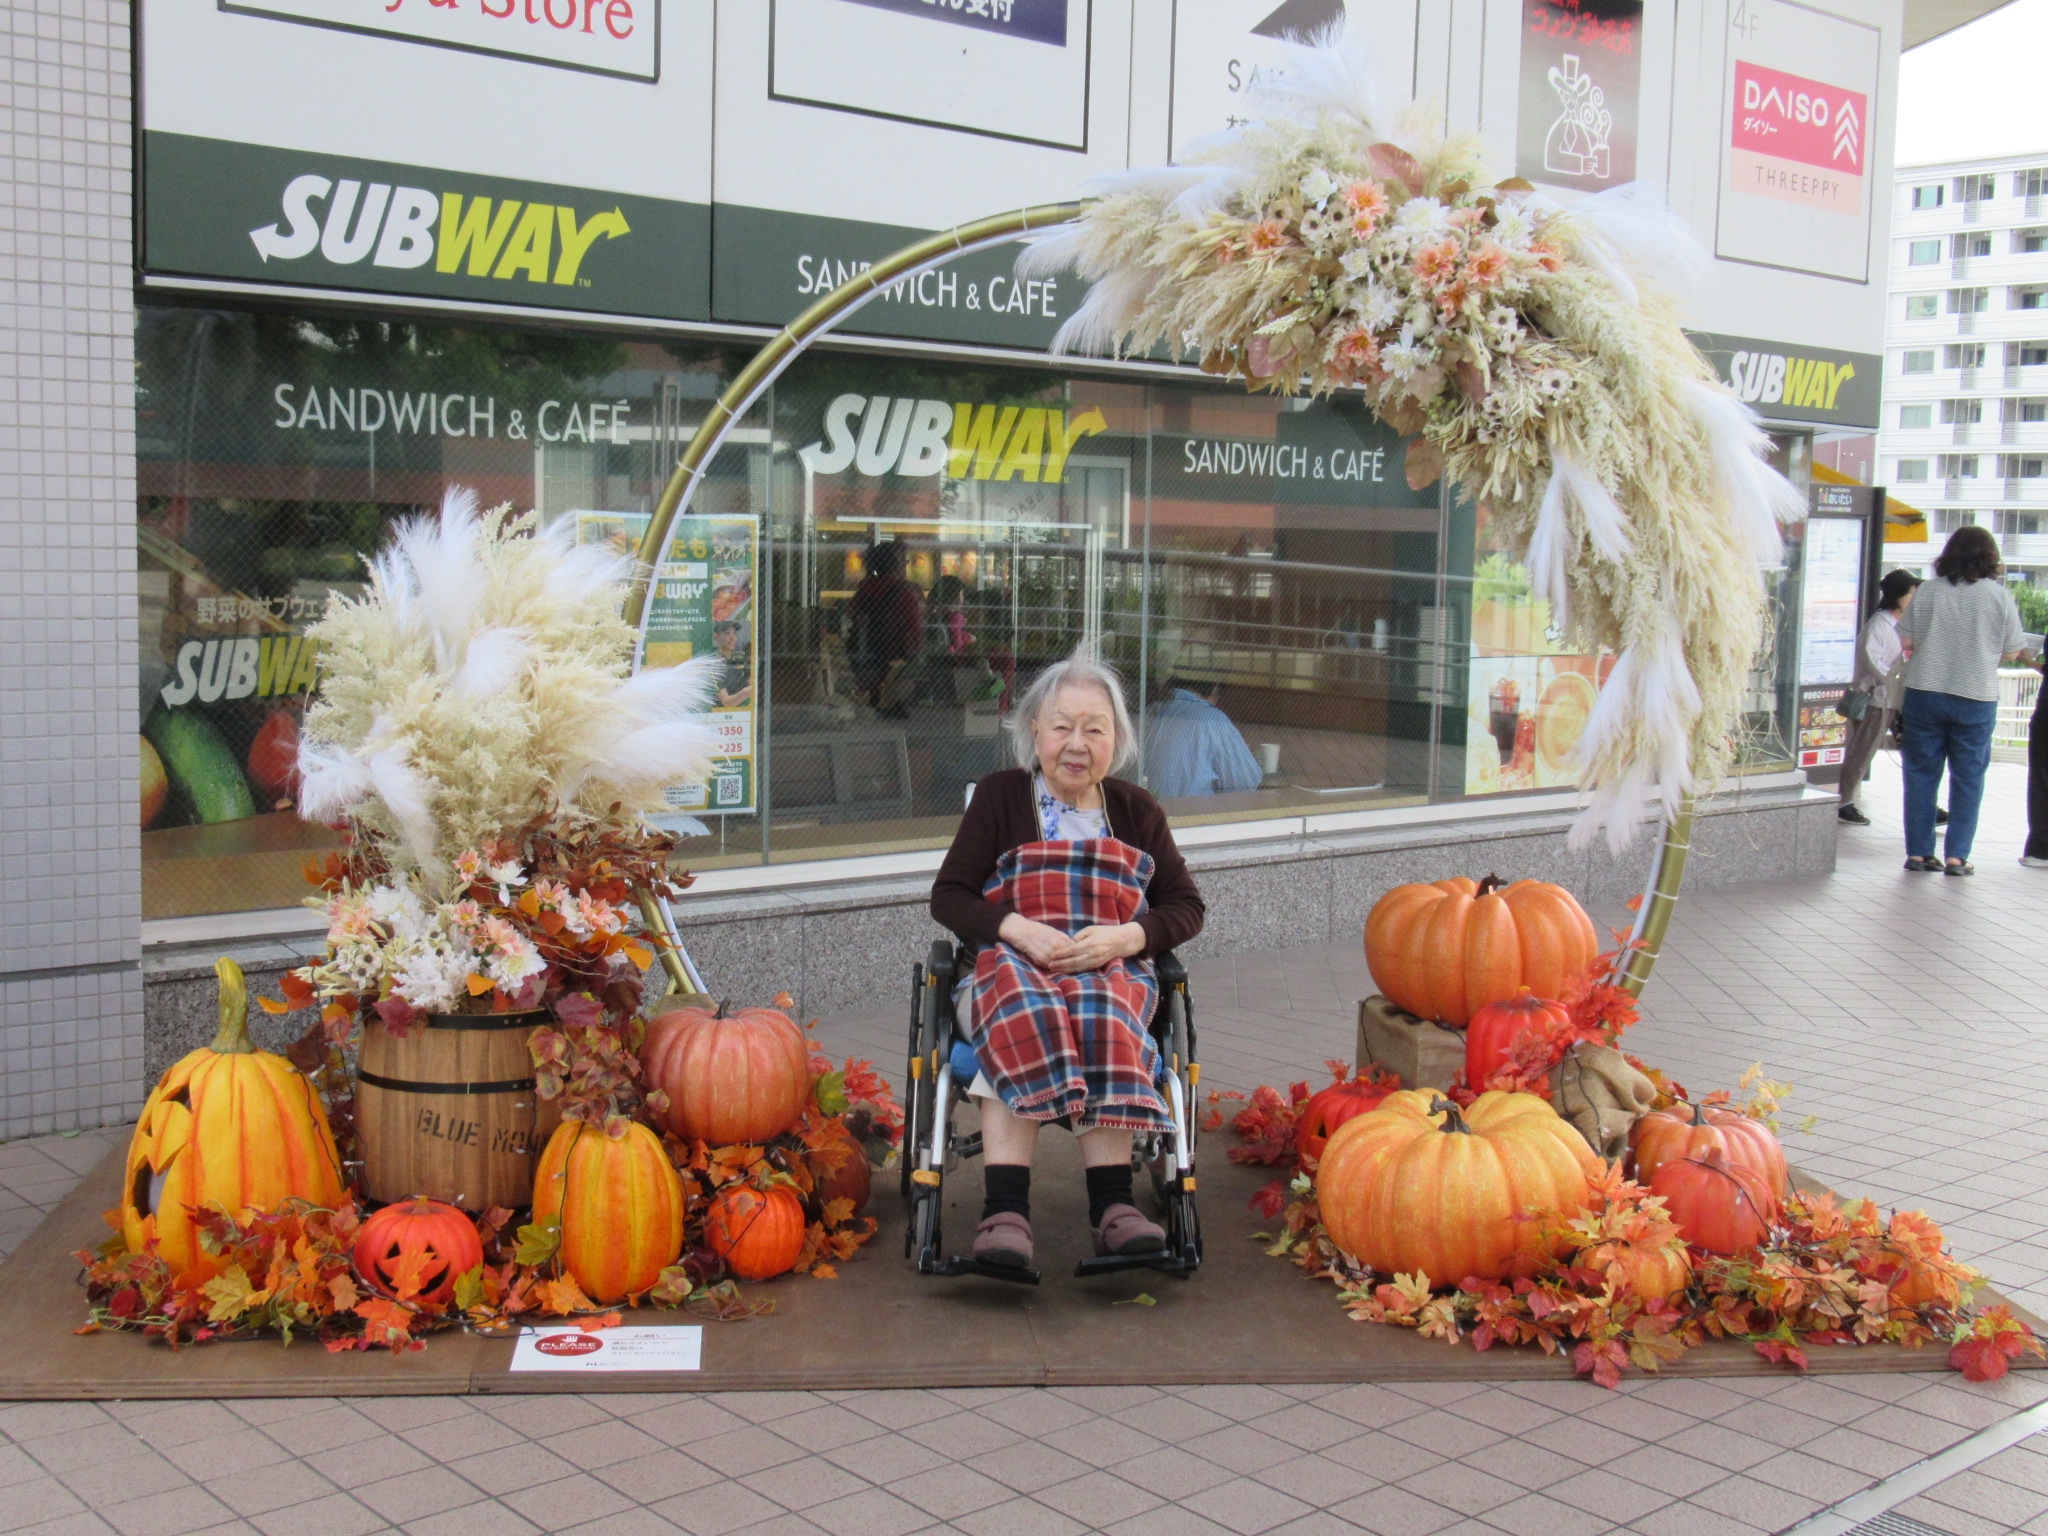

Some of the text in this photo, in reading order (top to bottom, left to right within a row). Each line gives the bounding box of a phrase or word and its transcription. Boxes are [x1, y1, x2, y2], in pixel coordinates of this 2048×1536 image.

[1732, 0, 1760, 40] 4F
[1744, 79, 1829, 127] DAISO
[1743, 117, 1778, 135] ダイソー
[1756, 166, 1839, 200] THREEPPY
[249, 174, 631, 287] SUBWAY
[965, 283, 982, 310] &
[988, 276, 1058, 317] CAFÉ
[1721, 350, 1856, 410] SUBWAY
[274, 384, 631, 446] SANDWICH & CAFÉ
[798, 393, 1108, 483] SUBWAY
[1183, 440, 1385, 482] SANDWICH & CAFÉ
[417, 1108, 482, 1147] BLUE
